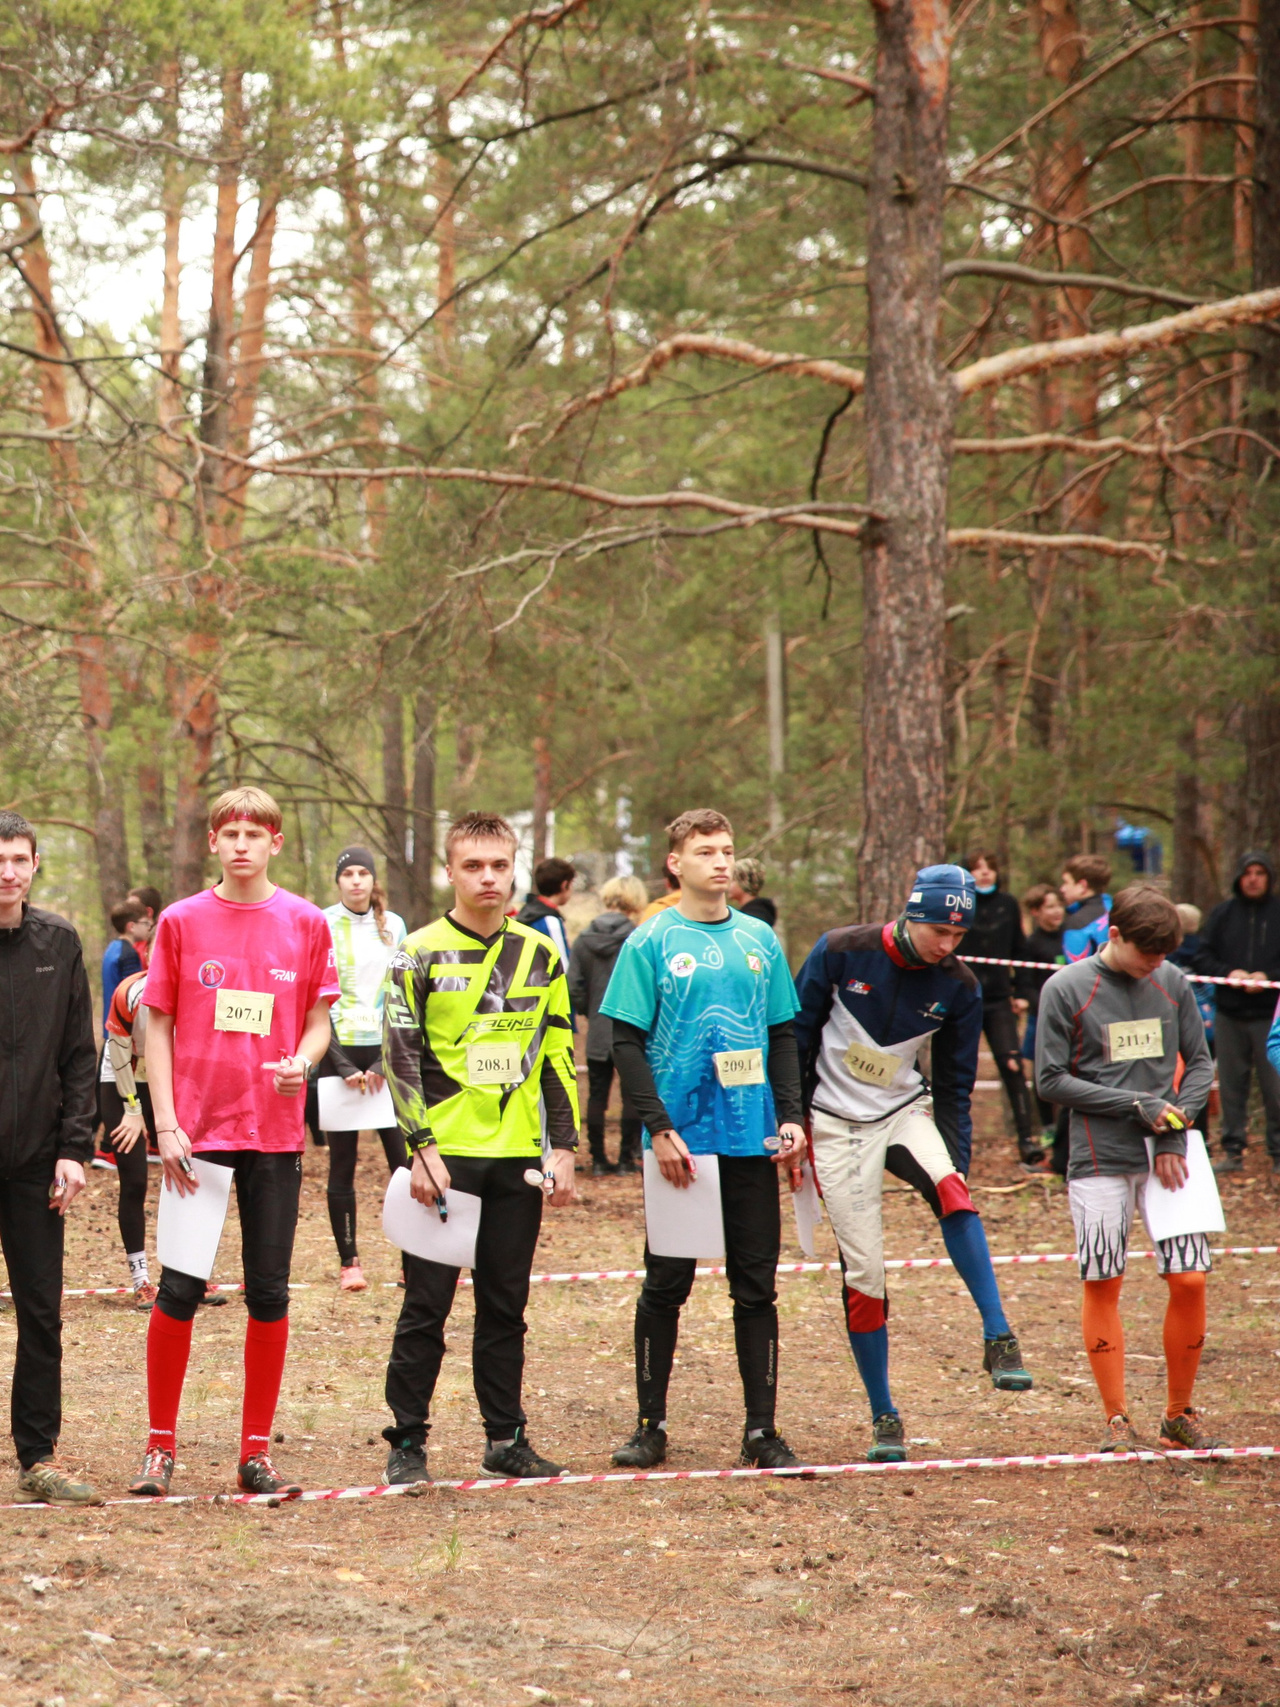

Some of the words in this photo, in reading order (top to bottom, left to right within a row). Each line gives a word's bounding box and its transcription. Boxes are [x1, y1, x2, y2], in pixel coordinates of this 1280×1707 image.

[945, 890, 973, 912] DNB
[226, 1006, 263, 1022] 207.1
[461, 1017, 535, 1037] RACING
[1117, 1033, 1150, 1048] 211.1
[476, 1058, 511, 1072] 208.1
[722, 1059, 752, 1073] 209.1
[851, 1056, 885, 1077] 210.1
